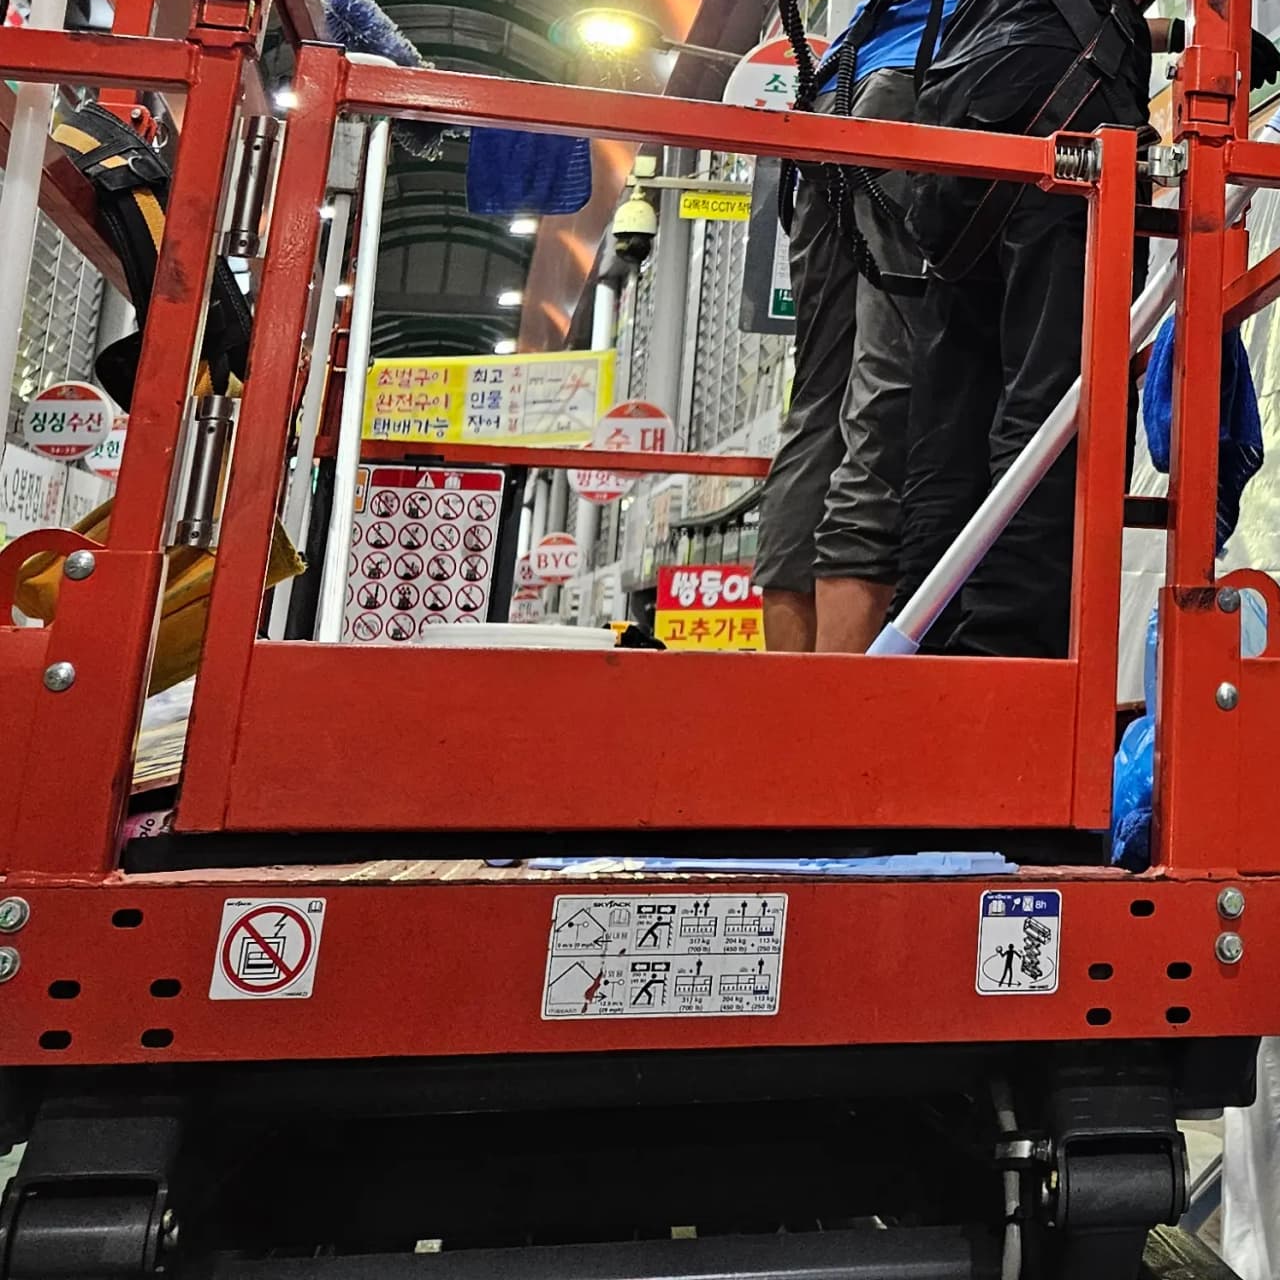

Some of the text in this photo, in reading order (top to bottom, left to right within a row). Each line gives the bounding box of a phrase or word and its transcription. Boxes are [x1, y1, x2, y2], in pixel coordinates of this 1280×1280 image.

[711, 200, 737, 213] CCTV
[377, 368, 448, 388] 초벌구이
[472, 368, 504, 383] 최고
[376, 393, 449, 412] 완전구이
[30, 411, 103, 433] 싱싱수산
[373, 418, 449, 440] 택배가능
[468, 414, 501, 434] 장어
[537, 551, 578, 569] BYC
[664, 617, 760, 643] 고추가루
